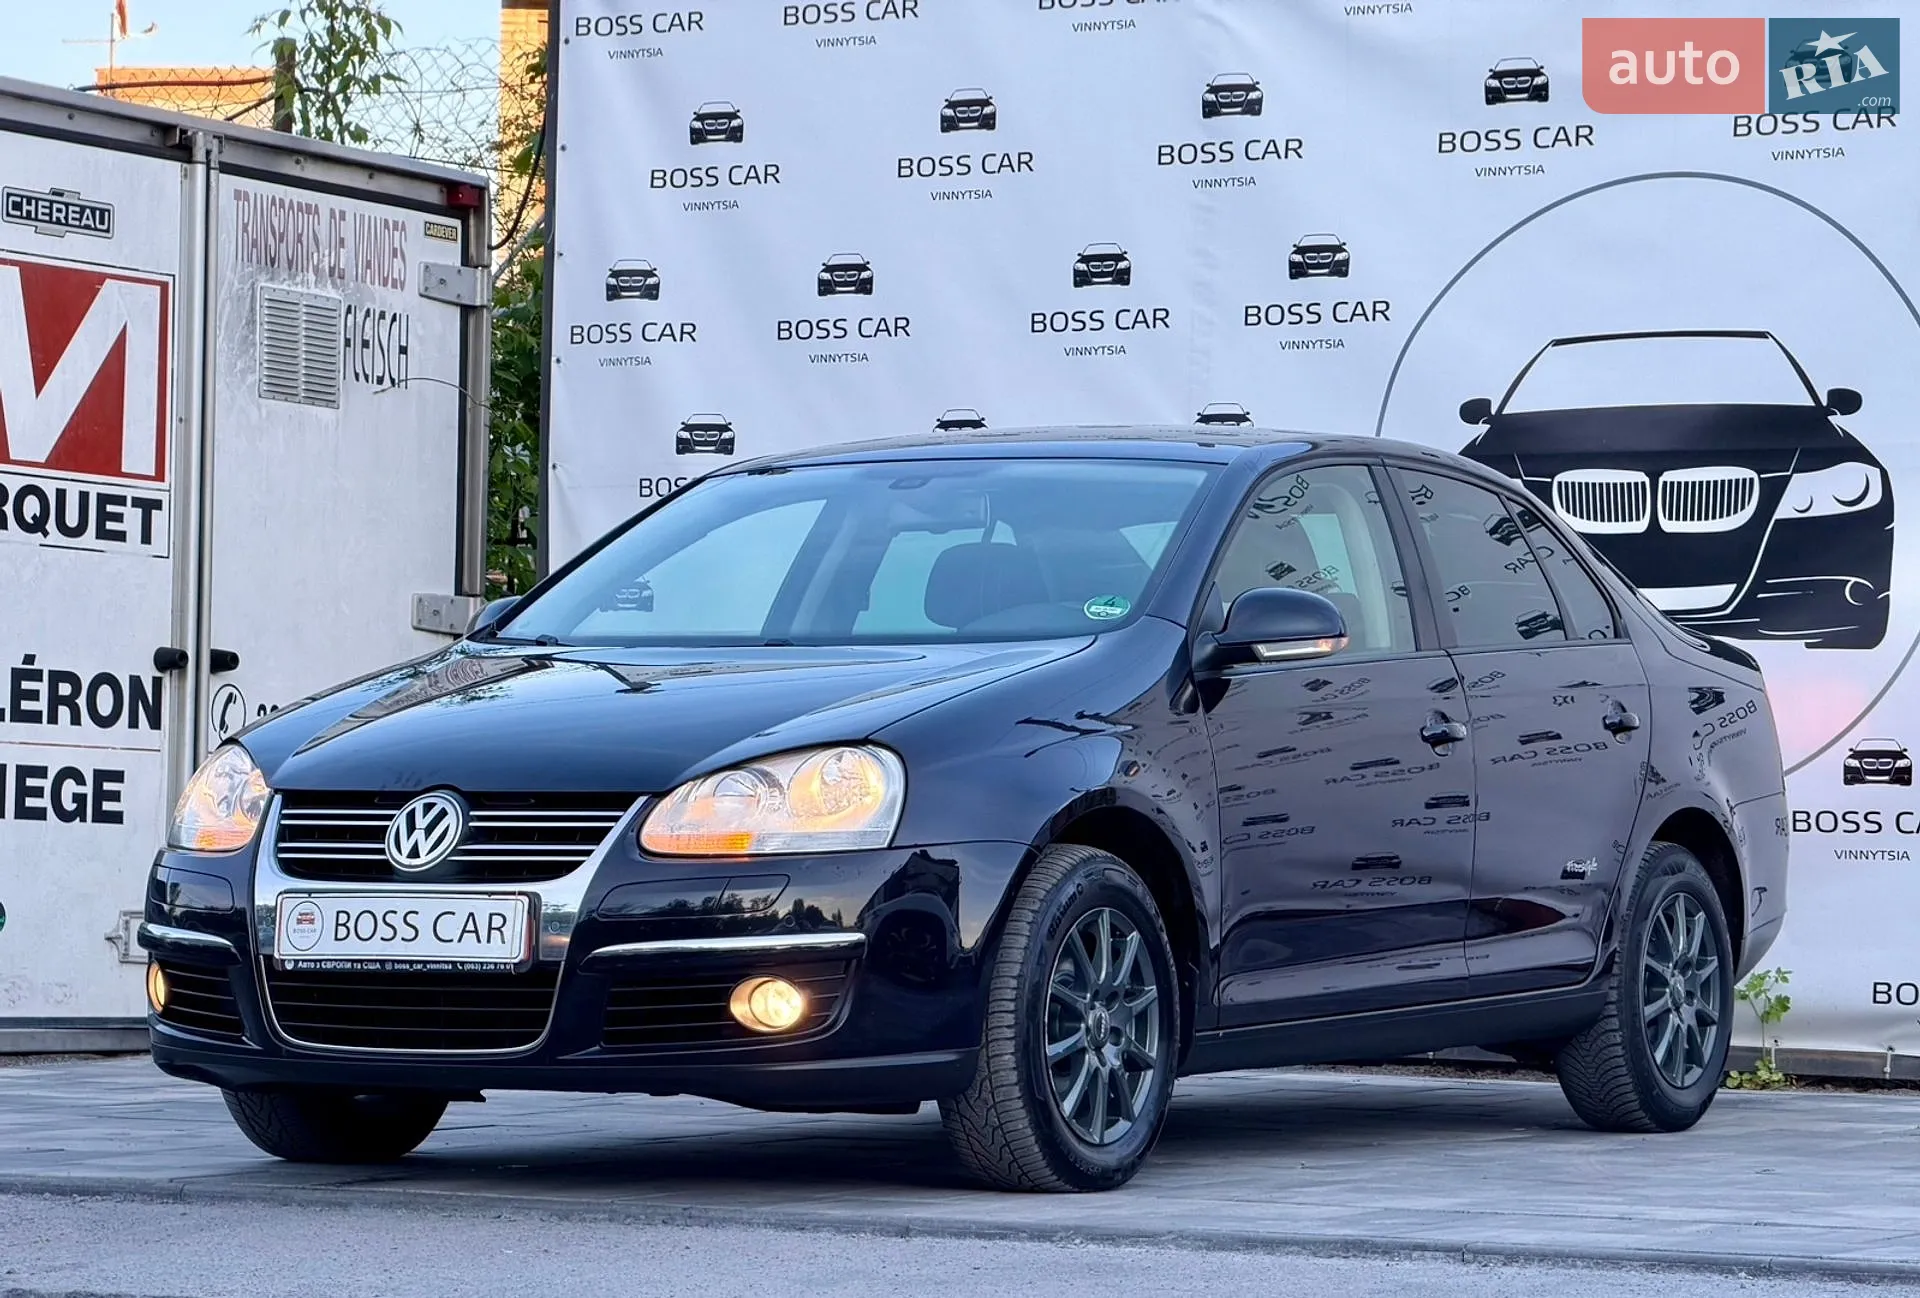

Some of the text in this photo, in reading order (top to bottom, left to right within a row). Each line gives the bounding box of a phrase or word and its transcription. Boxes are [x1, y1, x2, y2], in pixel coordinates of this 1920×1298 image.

[784, 0, 918, 25] BOSS CAR
[1344, 3, 1412, 16] VINNYTSIA
[576, 12, 703, 36] BOSS CAR
[1072, 20, 1136, 32] VINNYTSIA
[608, 48, 663, 59] VINNYTSIA
[816, 36, 876, 48] VINNYTSIA
[1733, 105, 1897, 137] BOSS CAR
[1439, 125, 1593, 153] BOSS CAR
[1158, 139, 1302, 165] BOSS CAR
[1772, 147, 1844, 160] VINNYTSIA
[651, 164, 780, 188] BOSS CAR
[898, 152, 1033, 177] BOSS CAR
[1475, 165, 1544, 176] VINNYTSIA
[1193, 177, 1256, 188] VINNYTSIA
[683, 200, 739, 211] VINNYTSIA
[931, 190, 992, 200] VINNYTSIA
[8, 195, 109, 231] CHEREAU
[233, 188, 408, 292] TRANSPORTS DE VIANDES
[1031, 308, 1169, 333] BOSS CAR
[1245, 301, 1390, 326] BOSS CAR
[571, 323, 696, 344] BOSS CAR
[778, 317, 910, 340] BOSS CAR
[343, 304, 409, 390] FLEISCH
[1064, 346, 1126, 356] VINNYTSIA
[1280, 339, 1344, 350] VINNYTSIA
[599, 356, 651, 367] VINNYTSIA
[809, 353, 868, 363] VINNYTSIA
[0, 482, 163, 545] QUET
[0, 654, 162, 731] ÉRON
[1793, 811, 1920, 834] BOSS C
[1834, 850, 1910, 860] VINNYTSIA
[334, 910, 506, 944] BOSS CAR
[362, 961, 381, 970] США
